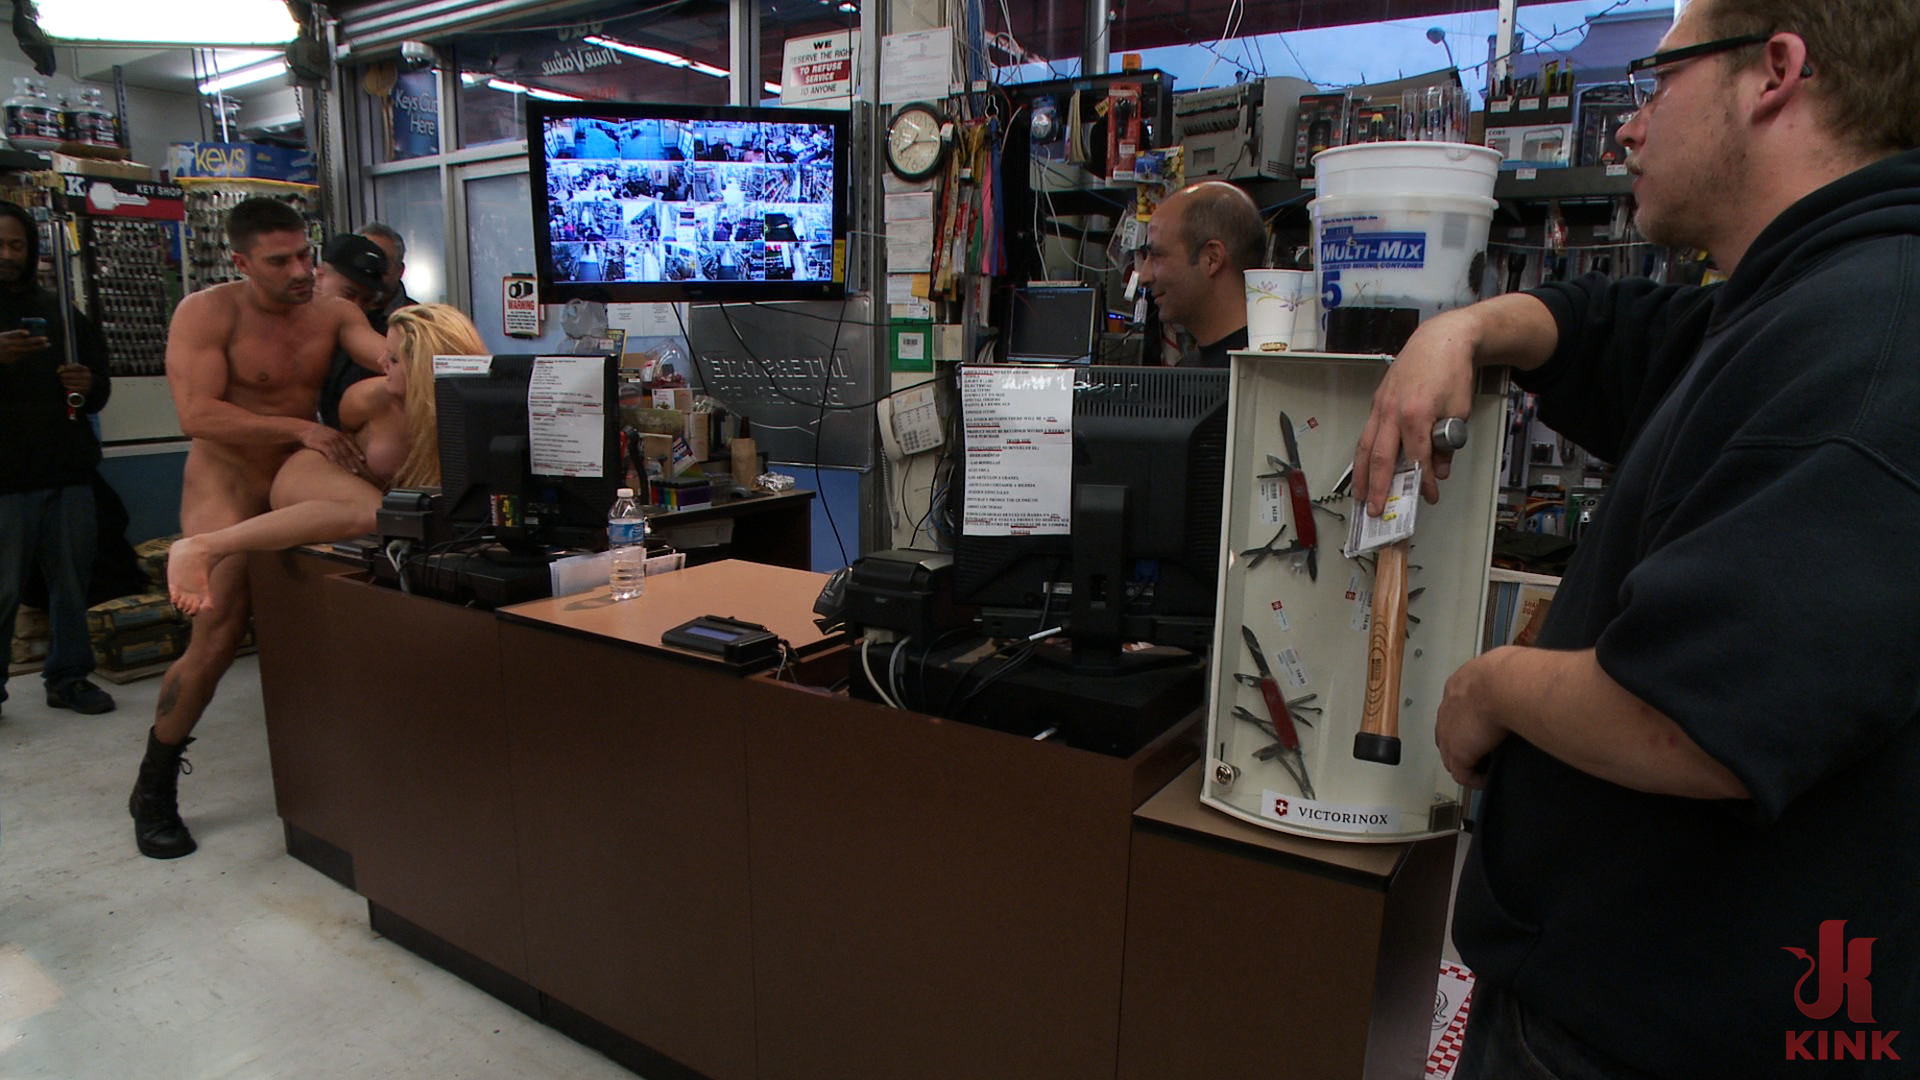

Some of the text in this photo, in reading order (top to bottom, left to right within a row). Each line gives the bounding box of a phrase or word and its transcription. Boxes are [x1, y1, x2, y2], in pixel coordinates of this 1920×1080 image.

[813, 39, 832, 51] WE
[790, 53, 818, 65] RESERVE
[820, 50, 833, 60] THE
[799, 61, 843, 76] TO REFUSE
[805, 71, 835, 85] SERVICE
[800, 83, 838, 97] TO ANYONE
[394, 89, 418, 116] Keys
[409, 113, 436, 136] Here
[194, 141, 247, 177] keys
[136, 183, 183, 199] KEY SHOP
[1352, 262, 1378, 270] MIXING
[1380, 261, 1425, 269] CONTAINER
[1322, 271, 1343, 308] 5
[508, 299, 535, 311] WARNING
[1297, 806, 1389, 826] VICTORINOX
